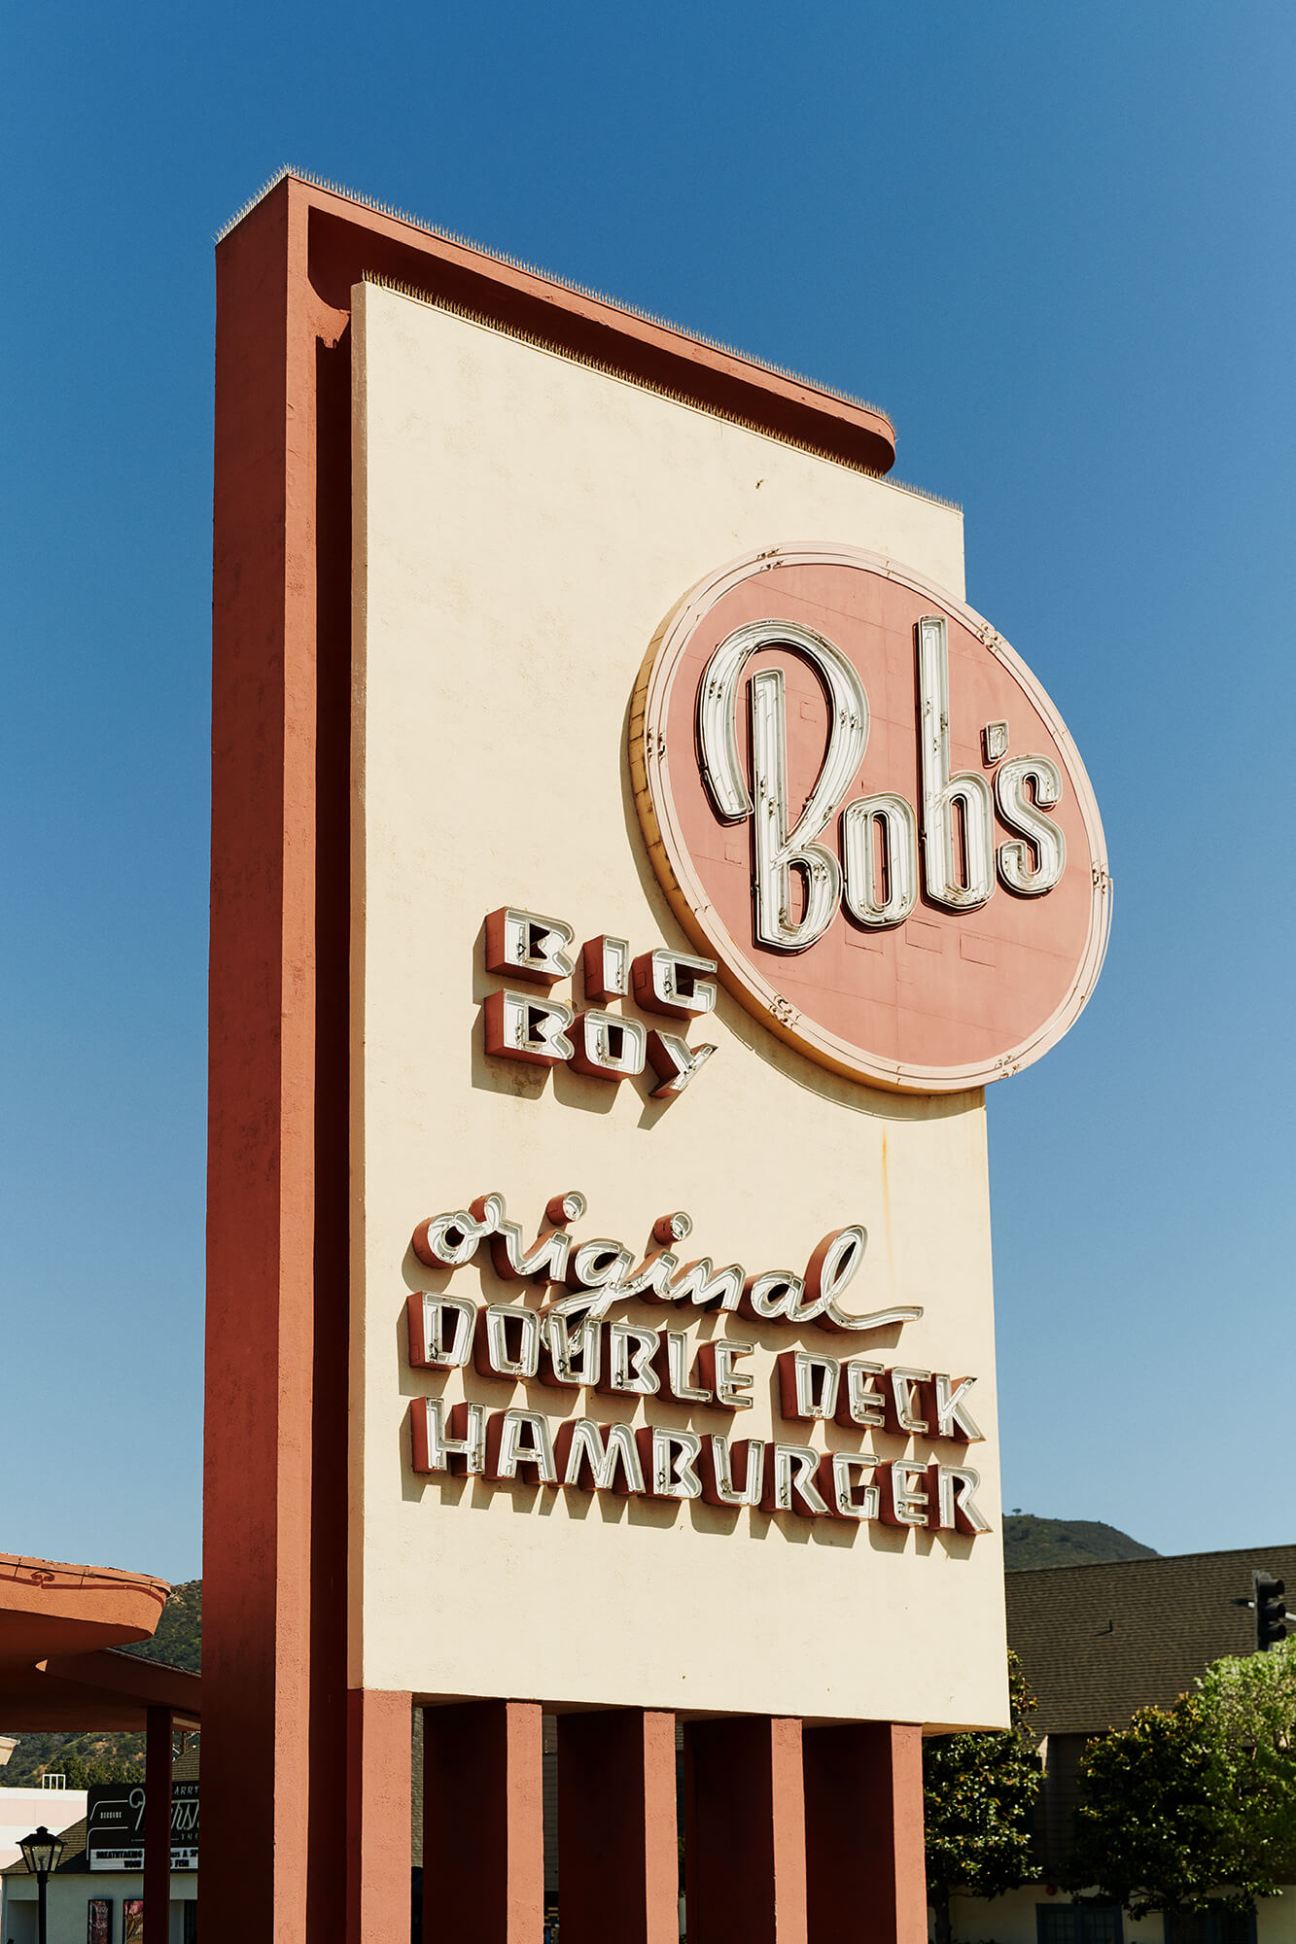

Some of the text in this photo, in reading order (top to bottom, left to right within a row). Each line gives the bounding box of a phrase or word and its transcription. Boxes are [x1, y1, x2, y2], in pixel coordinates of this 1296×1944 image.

[695, 614, 1066, 952] Bob's
[485, 906, 718, 1020] BIG
[484, 988, 718, 1098] BOY
[412, 1190, 924, 1357] original
[406, 1291, 985, 1443] DOUBLE DECK
[410, 1397, 993, 1535] HAMBURGER
